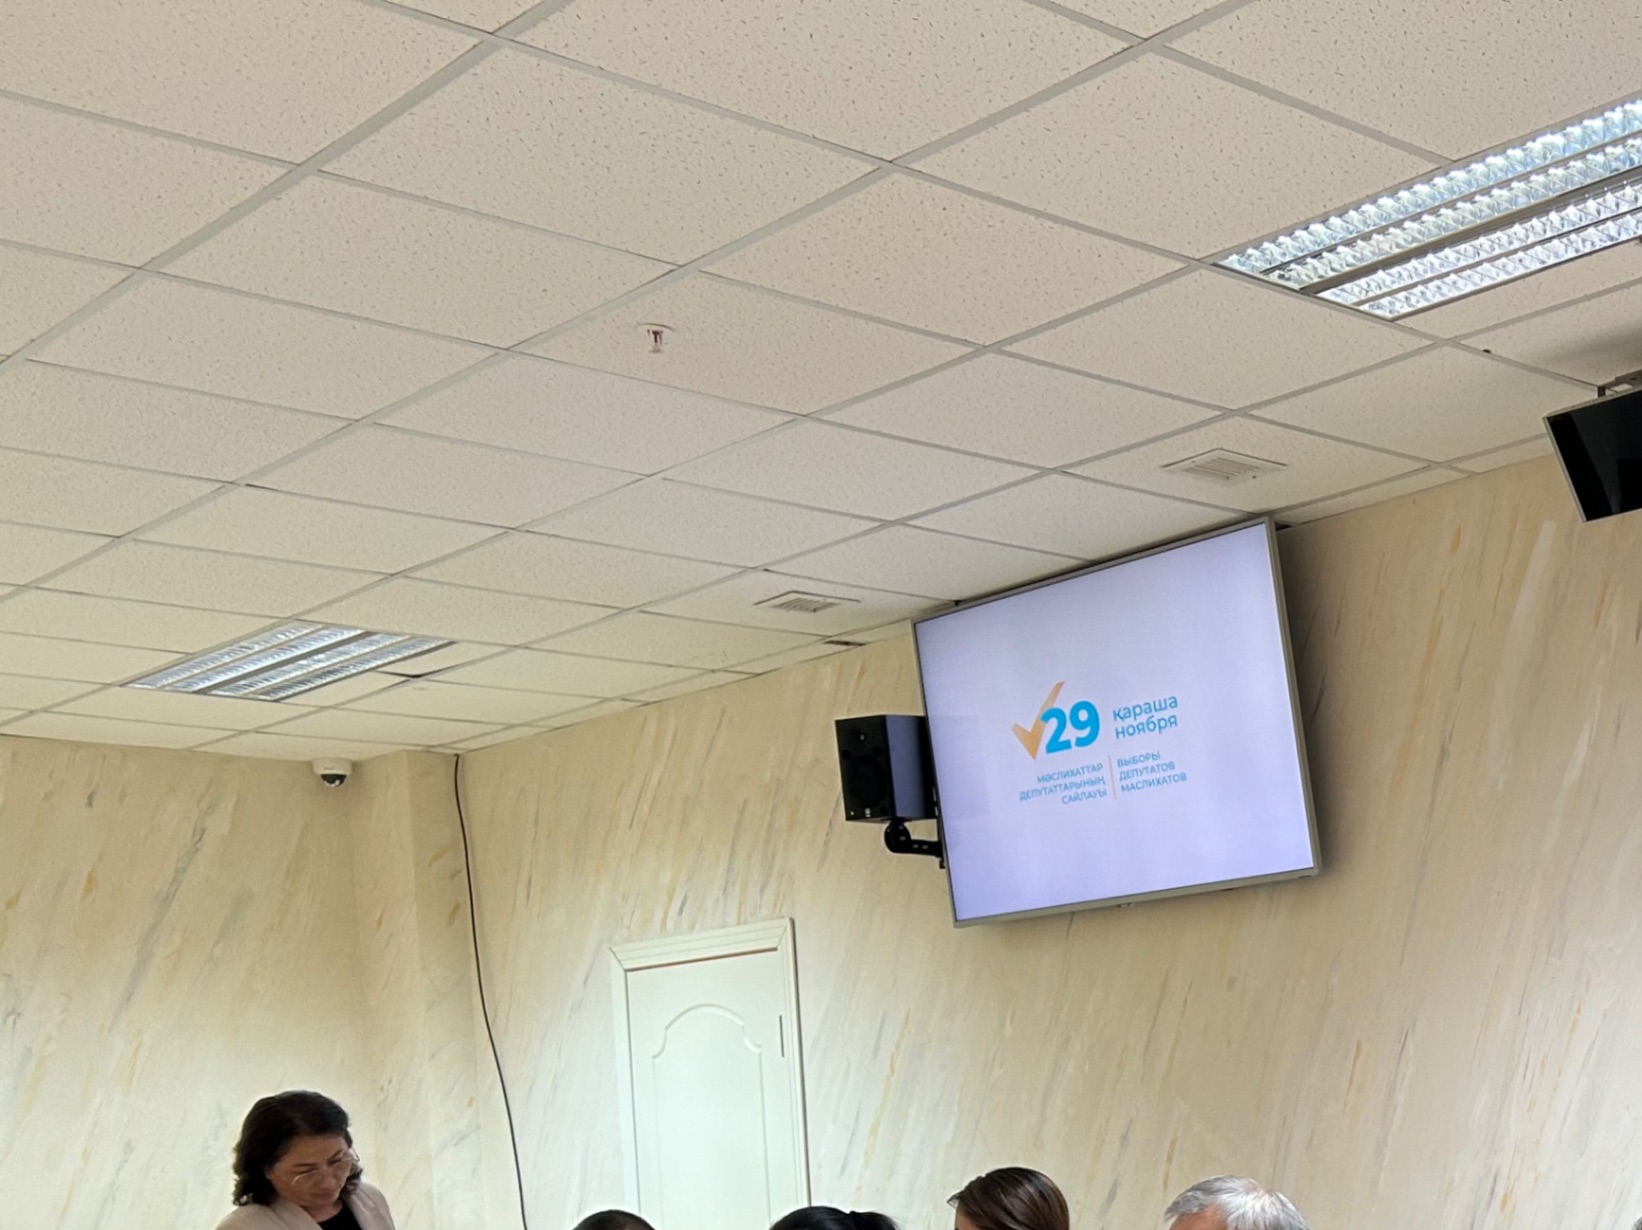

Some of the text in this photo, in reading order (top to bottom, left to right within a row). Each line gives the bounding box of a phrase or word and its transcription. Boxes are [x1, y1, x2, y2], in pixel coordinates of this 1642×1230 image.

[1112, 695, 1178, 722] қараша
[1040, 700, 1100, 754] 29
[1115, 714, 1178, 739] ноября
[1117, 751, 1161, 768] ВЫБОРЫ
[1037, 763, 1103, 784] МӘСЛИХАТТАР
[1119, 761, 1176, 782] ДЕПУТАТОВ
[1019, 775, 1106, 802] ДЕПУТАТТАРЫНЫҢ
[1120, 772, 1187, 793] МАСЛИХАТОВ
[1061, 788, 1107, 804] САЙЛАУЫ
